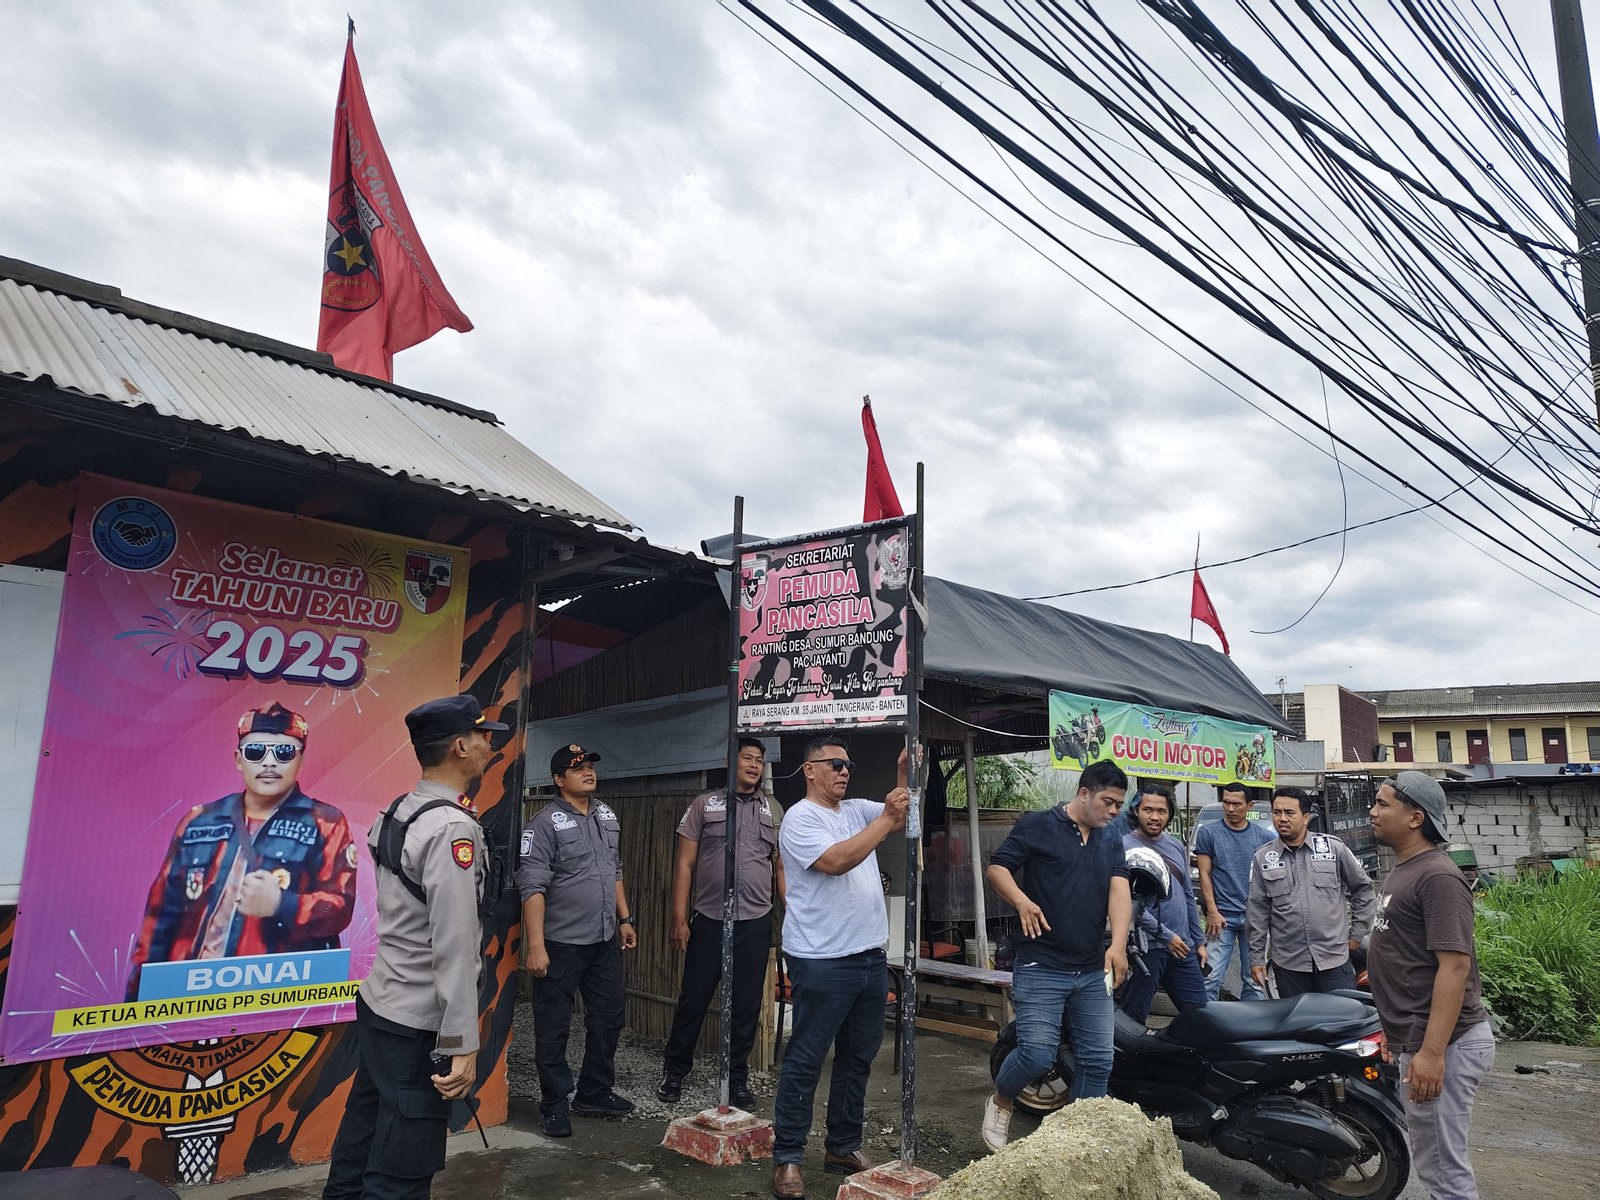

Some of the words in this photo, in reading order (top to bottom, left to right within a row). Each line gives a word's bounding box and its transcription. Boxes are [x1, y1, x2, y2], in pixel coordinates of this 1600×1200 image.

[219, 543, 364, 591] Selamat
[787, 544, 855, 568] SEKRETARIAT
[171, 568, 301, 614] TAHUN
[306, 590, 399, 627] BARU
[780, 568, 859, 604] PEMUDA
[767, 597, 874, 634] PANCASILA
[199, 620, 363, 682] 2025
[752, 641, 788, 656] RANTING
[815, 636, 847, 650] SUMUR
[849, 629, 894, 645] BANDUNG
[752, 708, 766, 717] RAYA
[767, 707, 790, 717] SERANG
[801, 706, 810, 715] 35
[836, 701, 874, 713] TANGERANG
[879, 699, 905, 711] BANTEN
[1112, 735, 1158, 763] CUCI
[1164, 741, 1227, 769] MOTOR
[186, 960, 312, 991] BONAI
[72, 1006, 137, 1027] KETUA
[144, 997, 227, 1019] RANTING
[233, 994, 254, 1009] PP
[1281, 1053, 1323, 1062] NMAX
[82, 1064, 172, 1119] PEMUDA
[179, 1050, 300, 1117] PANCASILA
